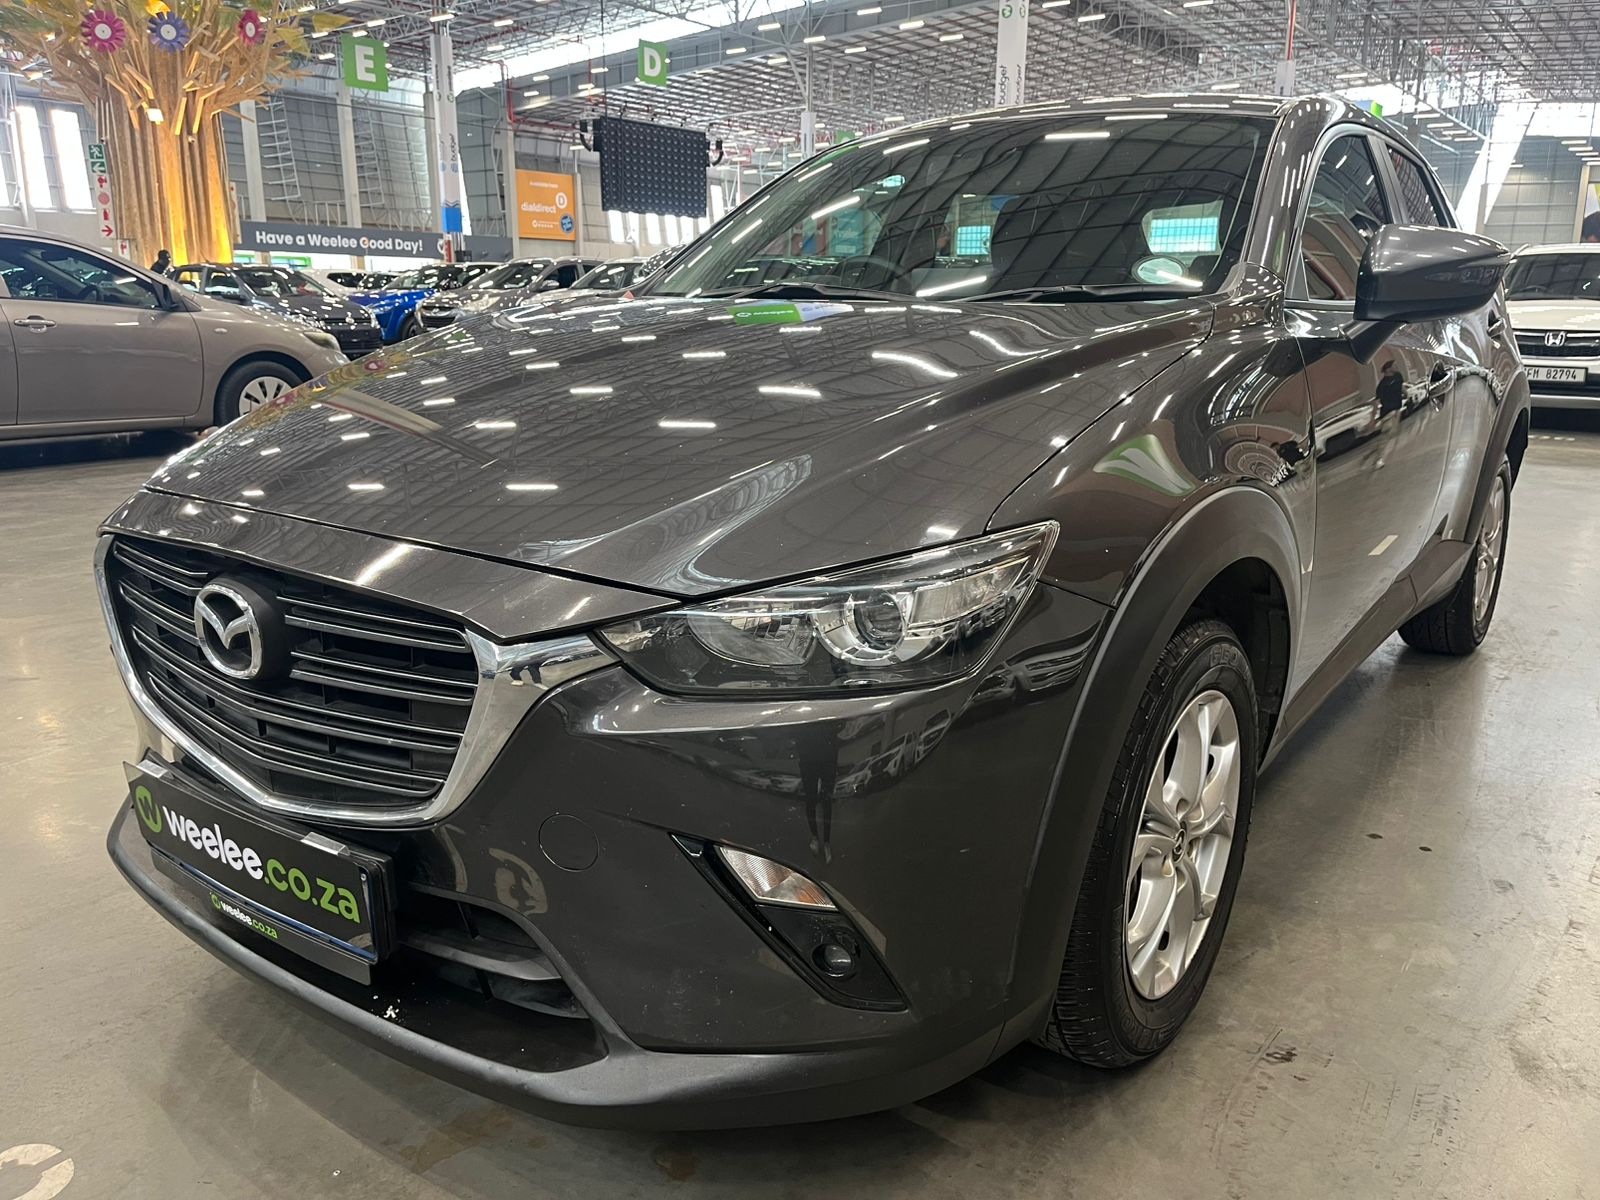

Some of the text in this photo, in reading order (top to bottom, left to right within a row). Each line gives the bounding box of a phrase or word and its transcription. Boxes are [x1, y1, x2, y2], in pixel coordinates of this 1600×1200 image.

[354, 45, 377, 82] E
[643, 47, 662, 77] D
[255, 230, 423, 255] Have a Weelee Good Day!
[1545, 368, 1577, 380] 82794
[162, 805, 361, 924] weelee.co.za
[220, 900, 278, 939] weelee.co.za
